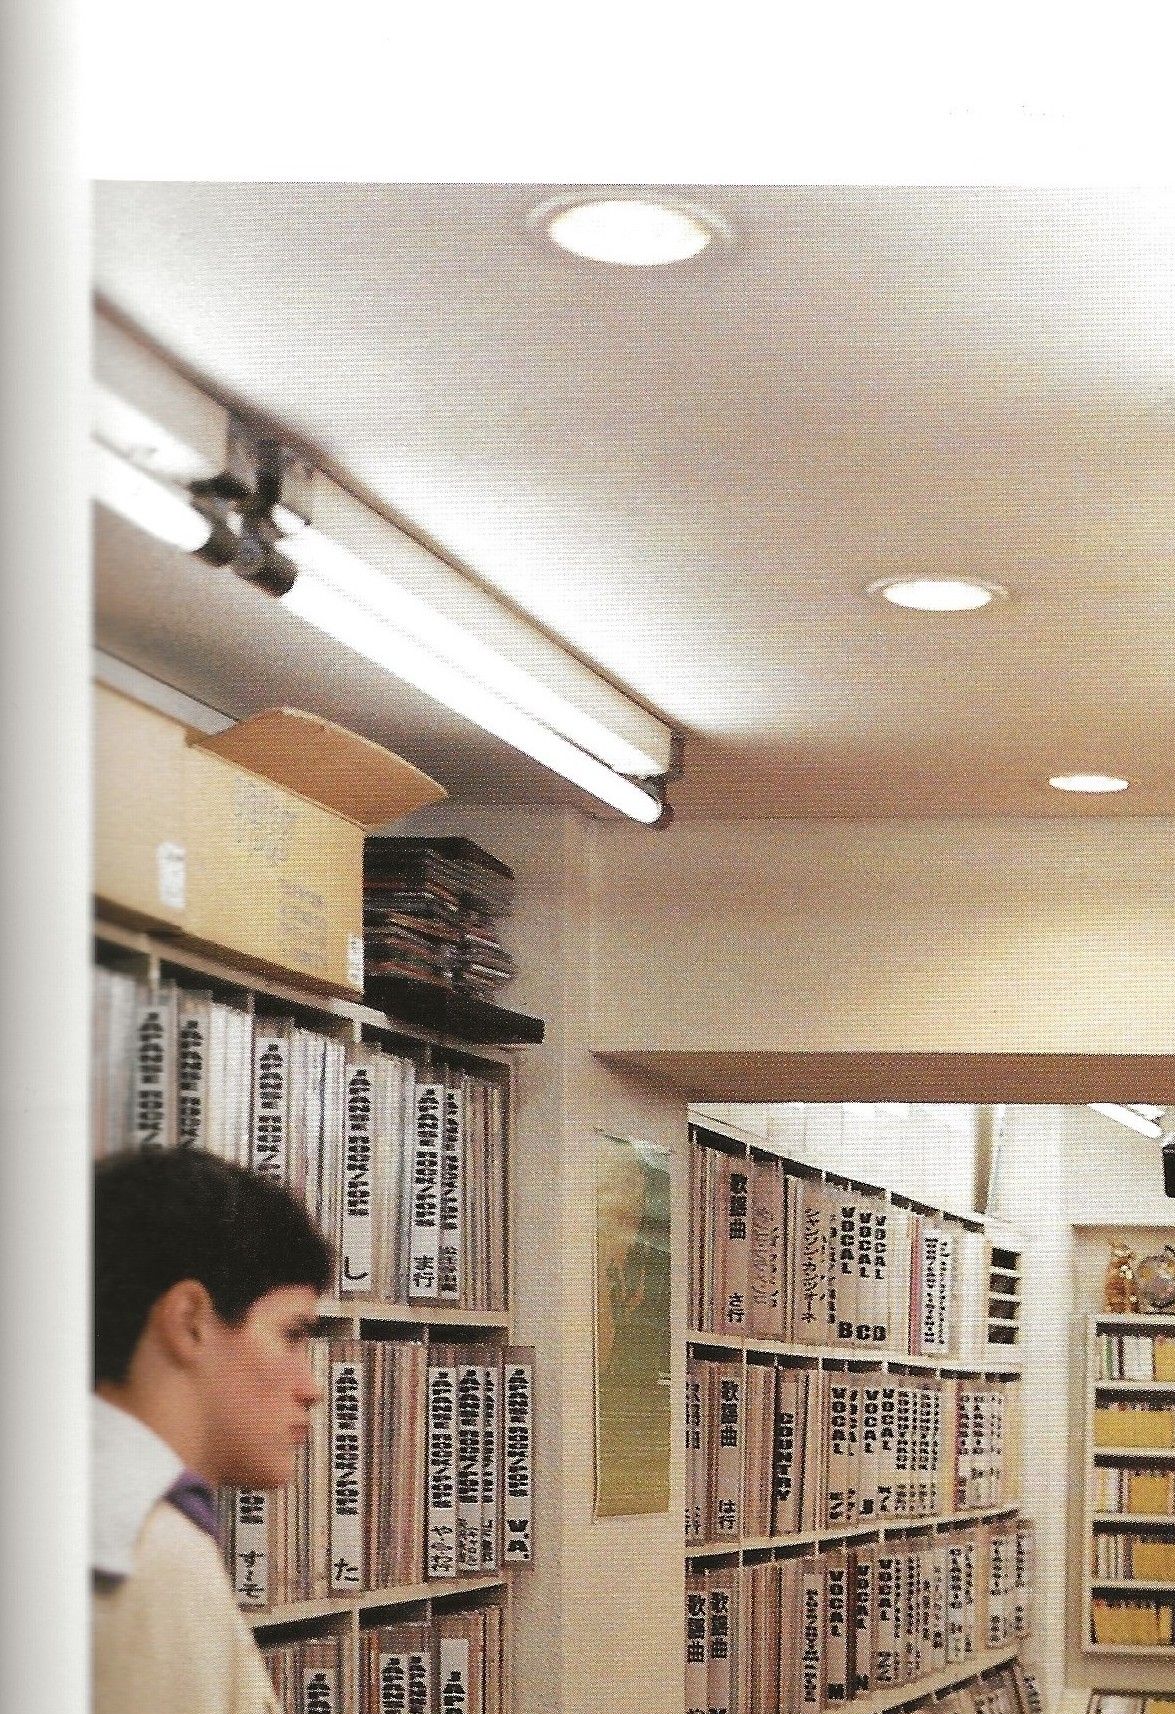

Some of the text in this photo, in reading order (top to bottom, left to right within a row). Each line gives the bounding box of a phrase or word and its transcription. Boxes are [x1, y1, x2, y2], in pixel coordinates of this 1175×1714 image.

[345, 1257, 369, 1280] し
[838, 1207, 856, 1339] VOCAL B
[856, 1213, 872, 1341] VOCAL C
[874, 1216, 887, 1279] VOCAL
[864, 1390, 879, 1454] VOCAL
[881, 1388, 895, 1451] VOCAL
[335, 1558, 359, 1582] た
[878, 1559, 893, 1622] VOCAL
[829, 1570, 844, 1638] VOCAL
